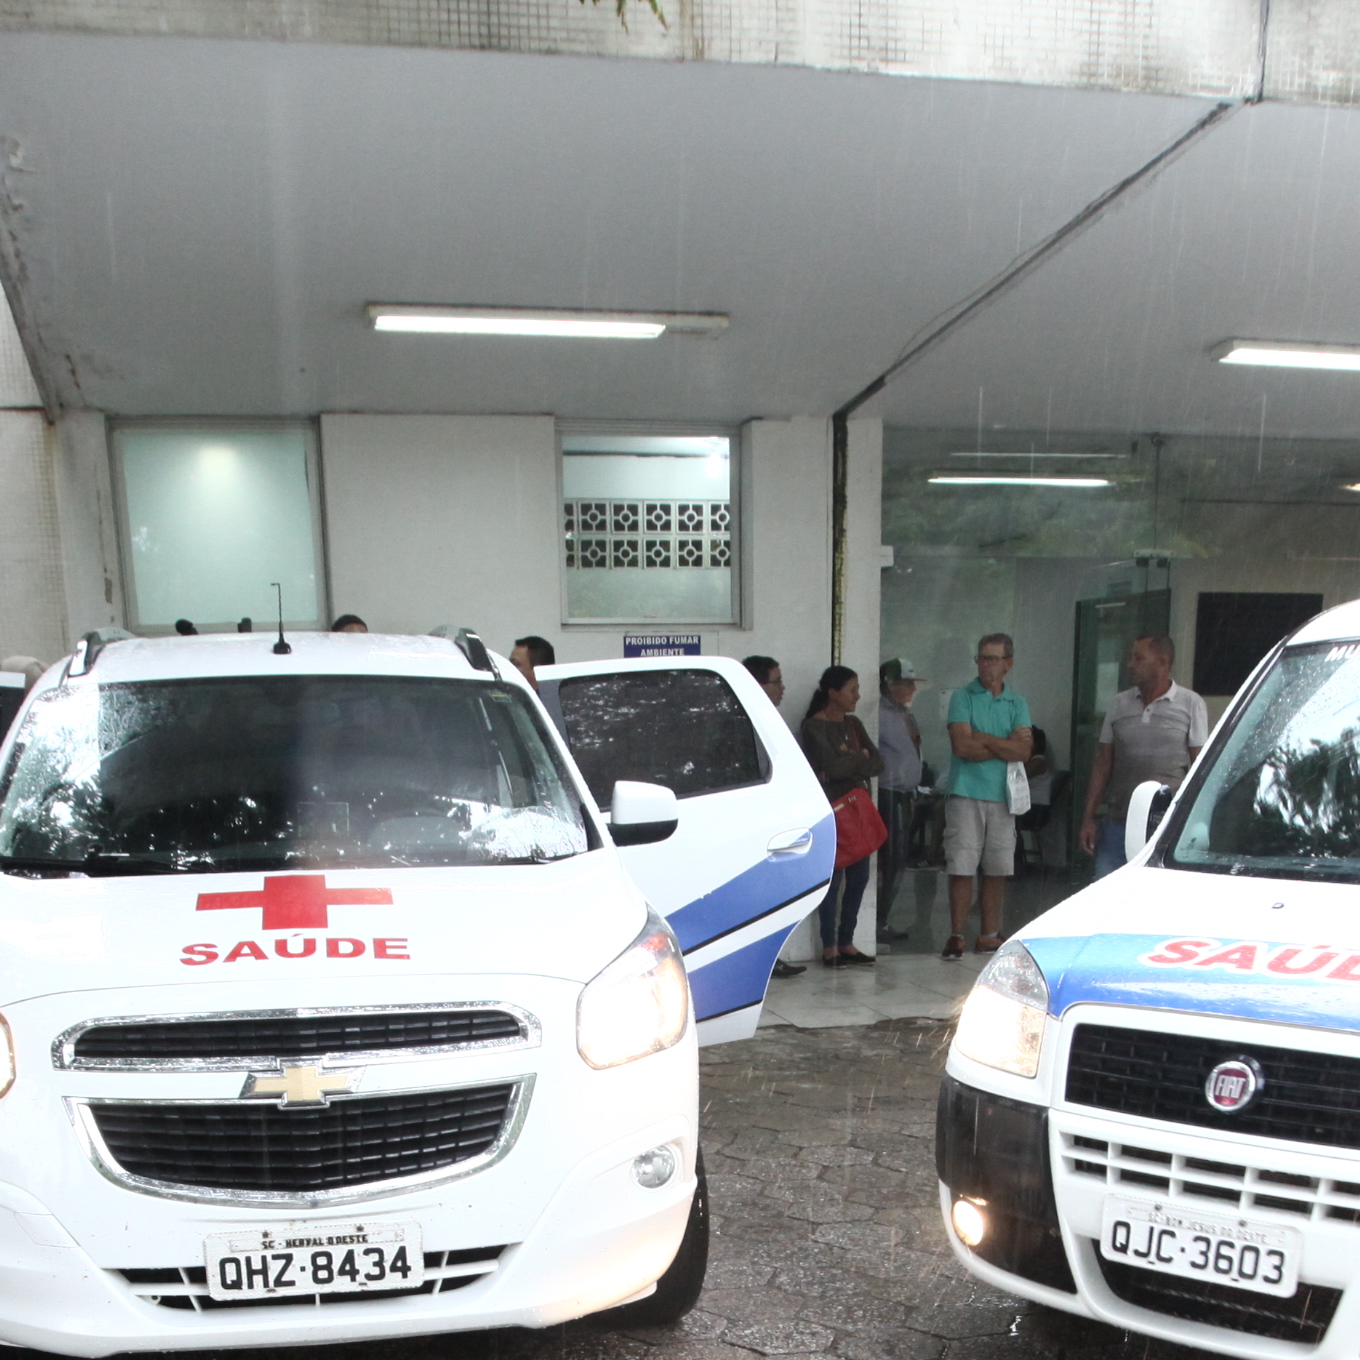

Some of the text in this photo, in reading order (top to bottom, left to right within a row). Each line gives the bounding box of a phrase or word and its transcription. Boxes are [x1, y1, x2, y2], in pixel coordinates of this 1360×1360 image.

[625, 636, 699, 646] PROIBIDO FUMAR
[640, 648, 685, 657] AMBIENTE
[179, 933, 411, 966] SAÚDE
[1214, 1074, 1247, 1099] FIAT
[261, 1240, 275, 1249] SC
